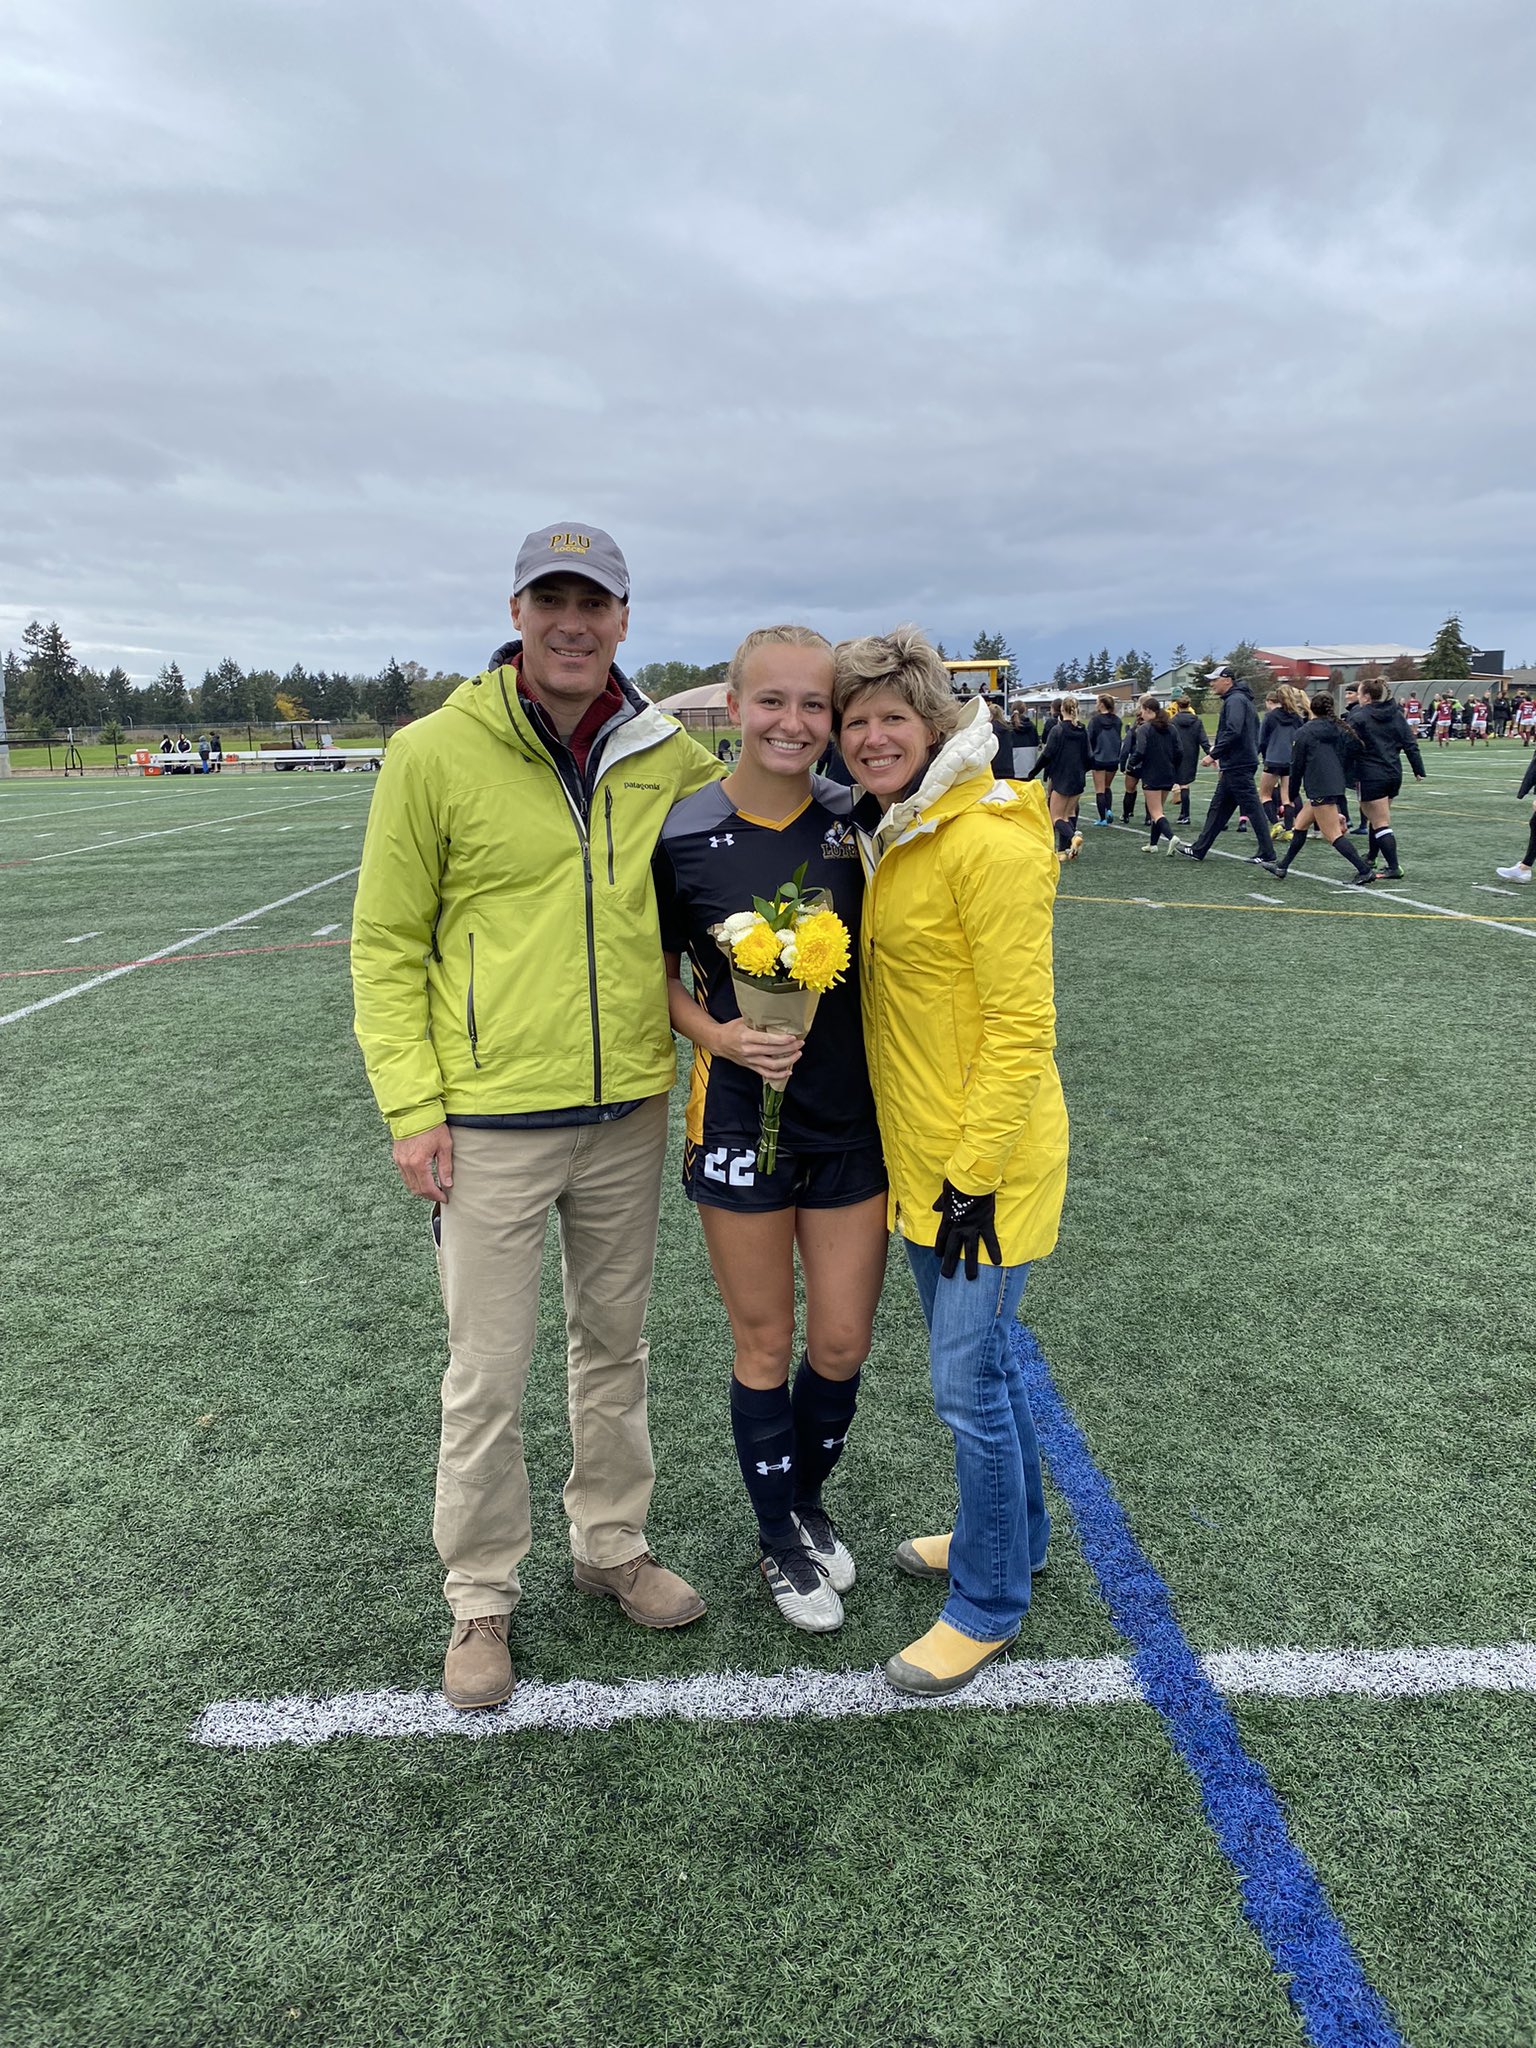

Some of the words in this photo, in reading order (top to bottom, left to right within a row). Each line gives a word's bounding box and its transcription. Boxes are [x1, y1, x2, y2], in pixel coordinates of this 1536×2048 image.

[548, 532, 591, 549] PLU
[554, 546, 586, 555] SOCCER
[623, 781, 661, 791] patagonia
[704, 1147, 756, 1187] 22
